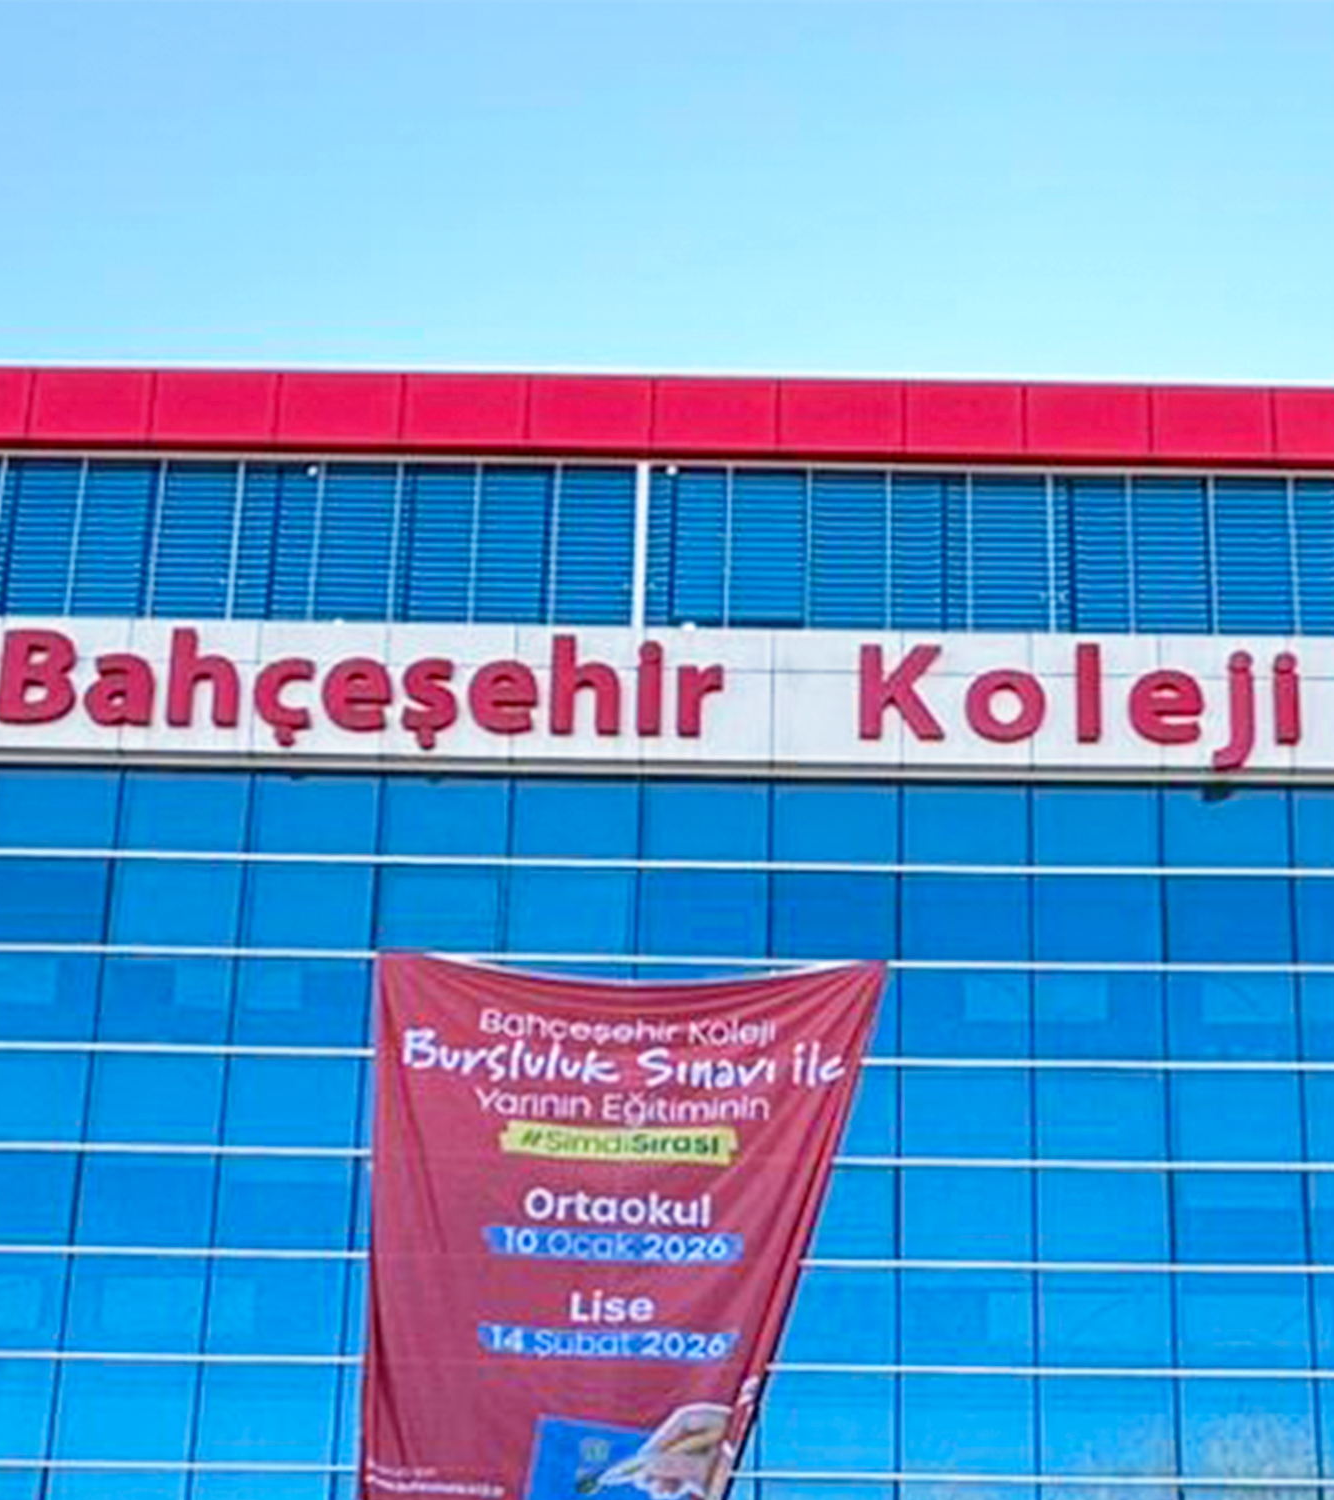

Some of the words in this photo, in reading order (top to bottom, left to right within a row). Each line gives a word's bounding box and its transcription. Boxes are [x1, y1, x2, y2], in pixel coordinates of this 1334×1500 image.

[858, 642, 1301, 771] Koleji
[688, 1016, 775, 1047] Koleji
[402, 1027, 620, 1084] Bursluluk
[637, 1048, 773, 1087] Sınavı
[794, 1042, 845, 1085] ile
[602, 1090, 769, 1126] Eğitiminin
[524, 1187, 712, 1227] Ortaokul
[505, 1228, 538, 1253] 10
[547, 1230, 634, 1257] Ocak
[642, 1234, 728, 1260] 2026
[570, 1290, 655, 1322] Lise
[491, 1325, 524, 1351] 14
[641, 1332, 727, 1358] 2026
